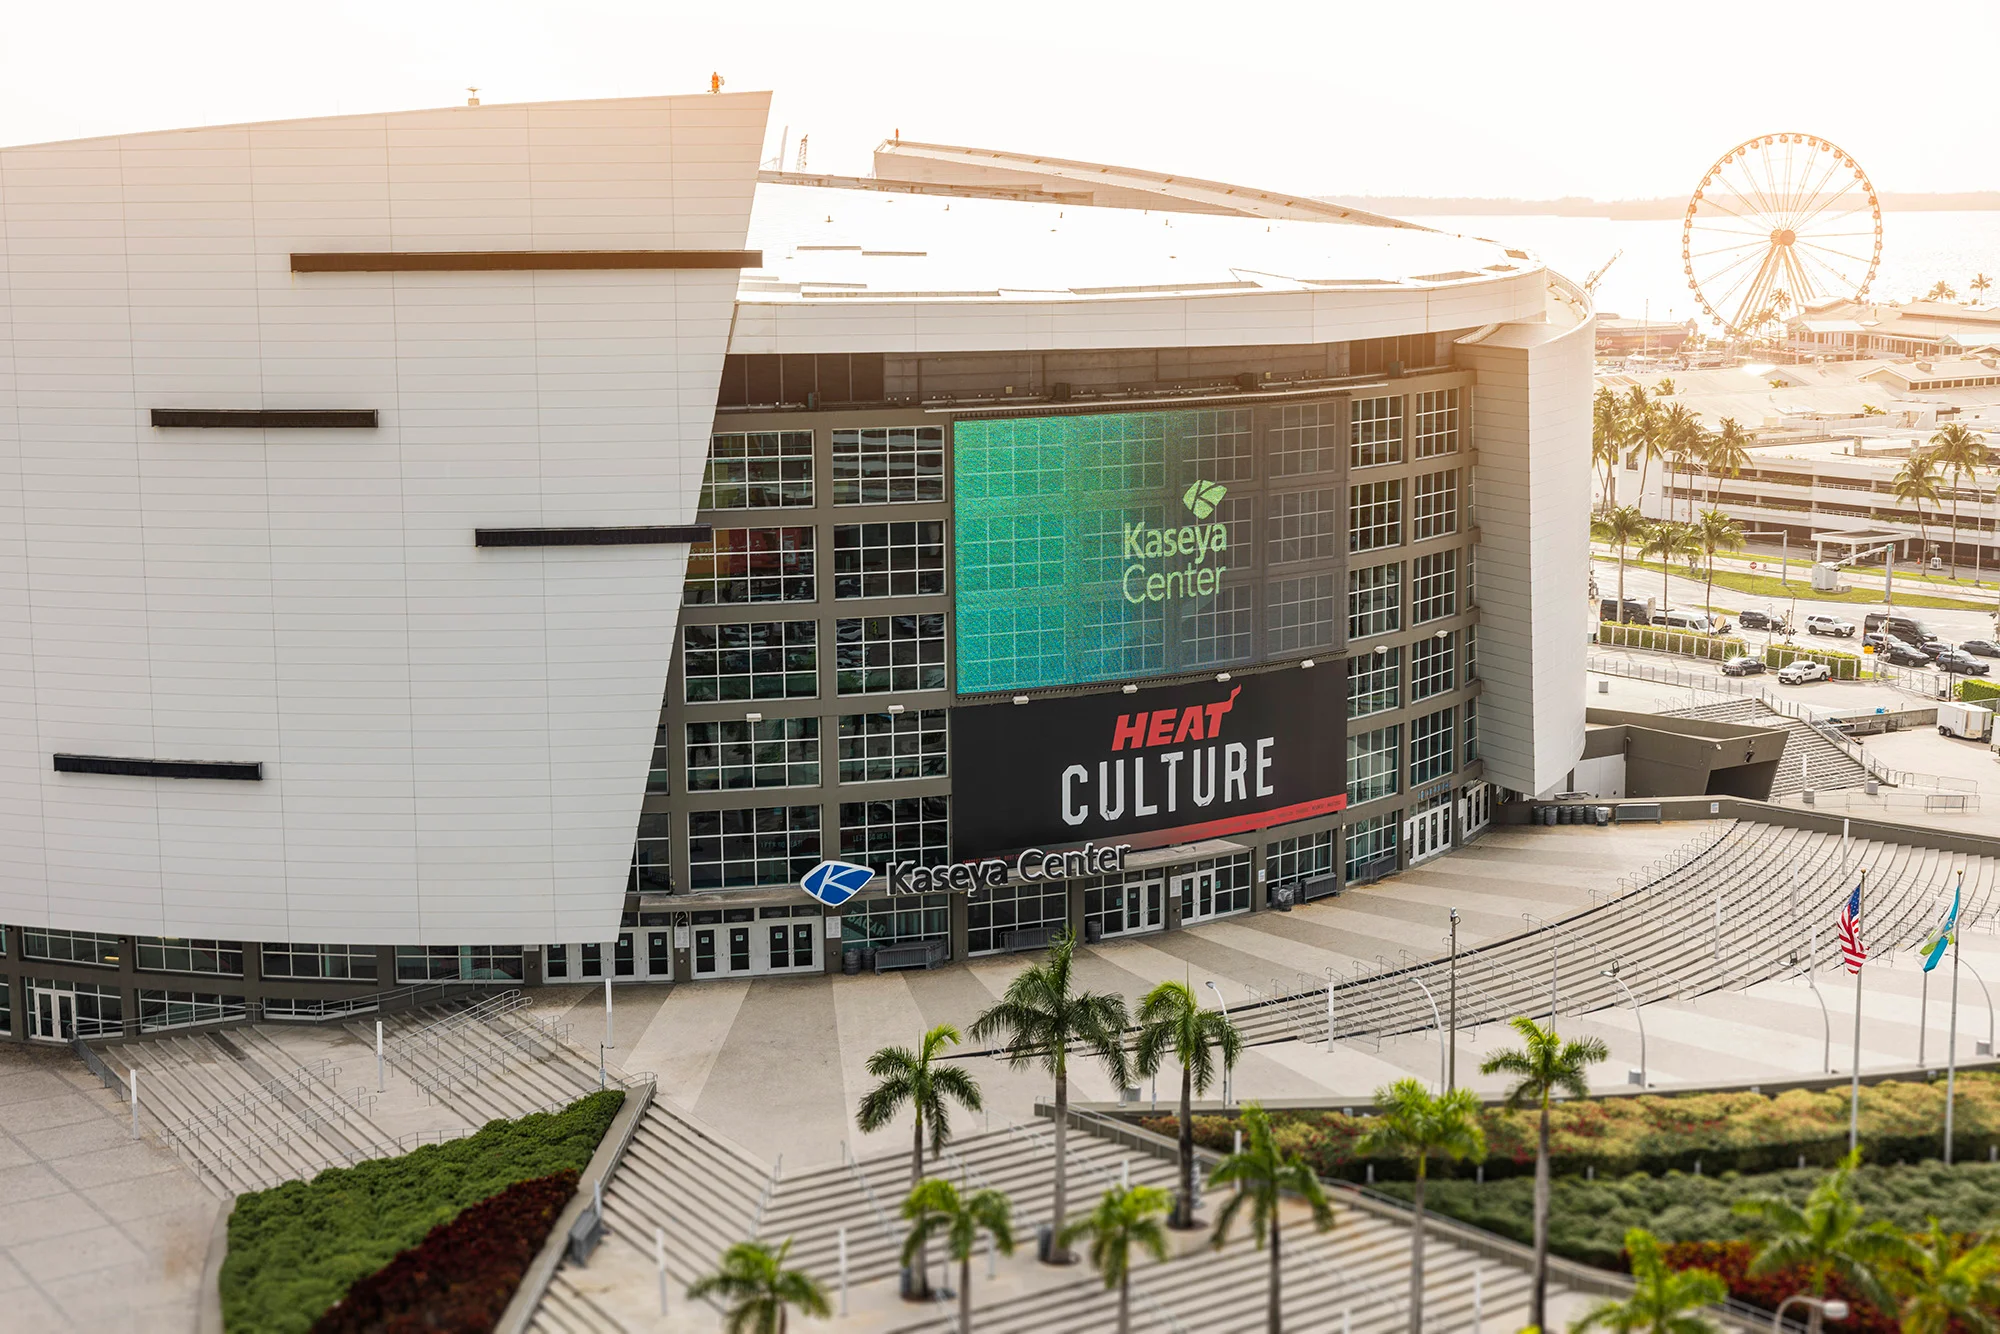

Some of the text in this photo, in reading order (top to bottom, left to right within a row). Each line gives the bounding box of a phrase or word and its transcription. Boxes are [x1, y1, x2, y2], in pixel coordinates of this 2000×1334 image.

[1596, 336, 1613, 348] afe
[1124, 521, 1228, 565] Kaseya
[1122, 562, 1227, 604] Center
[1111, 684, 1242, 751] HEAT
[1061, 736, 1275, 826] CULTURE
[886, 859, 1009, 897] Kaseya
[1016, 842, 1131, 883] Center
